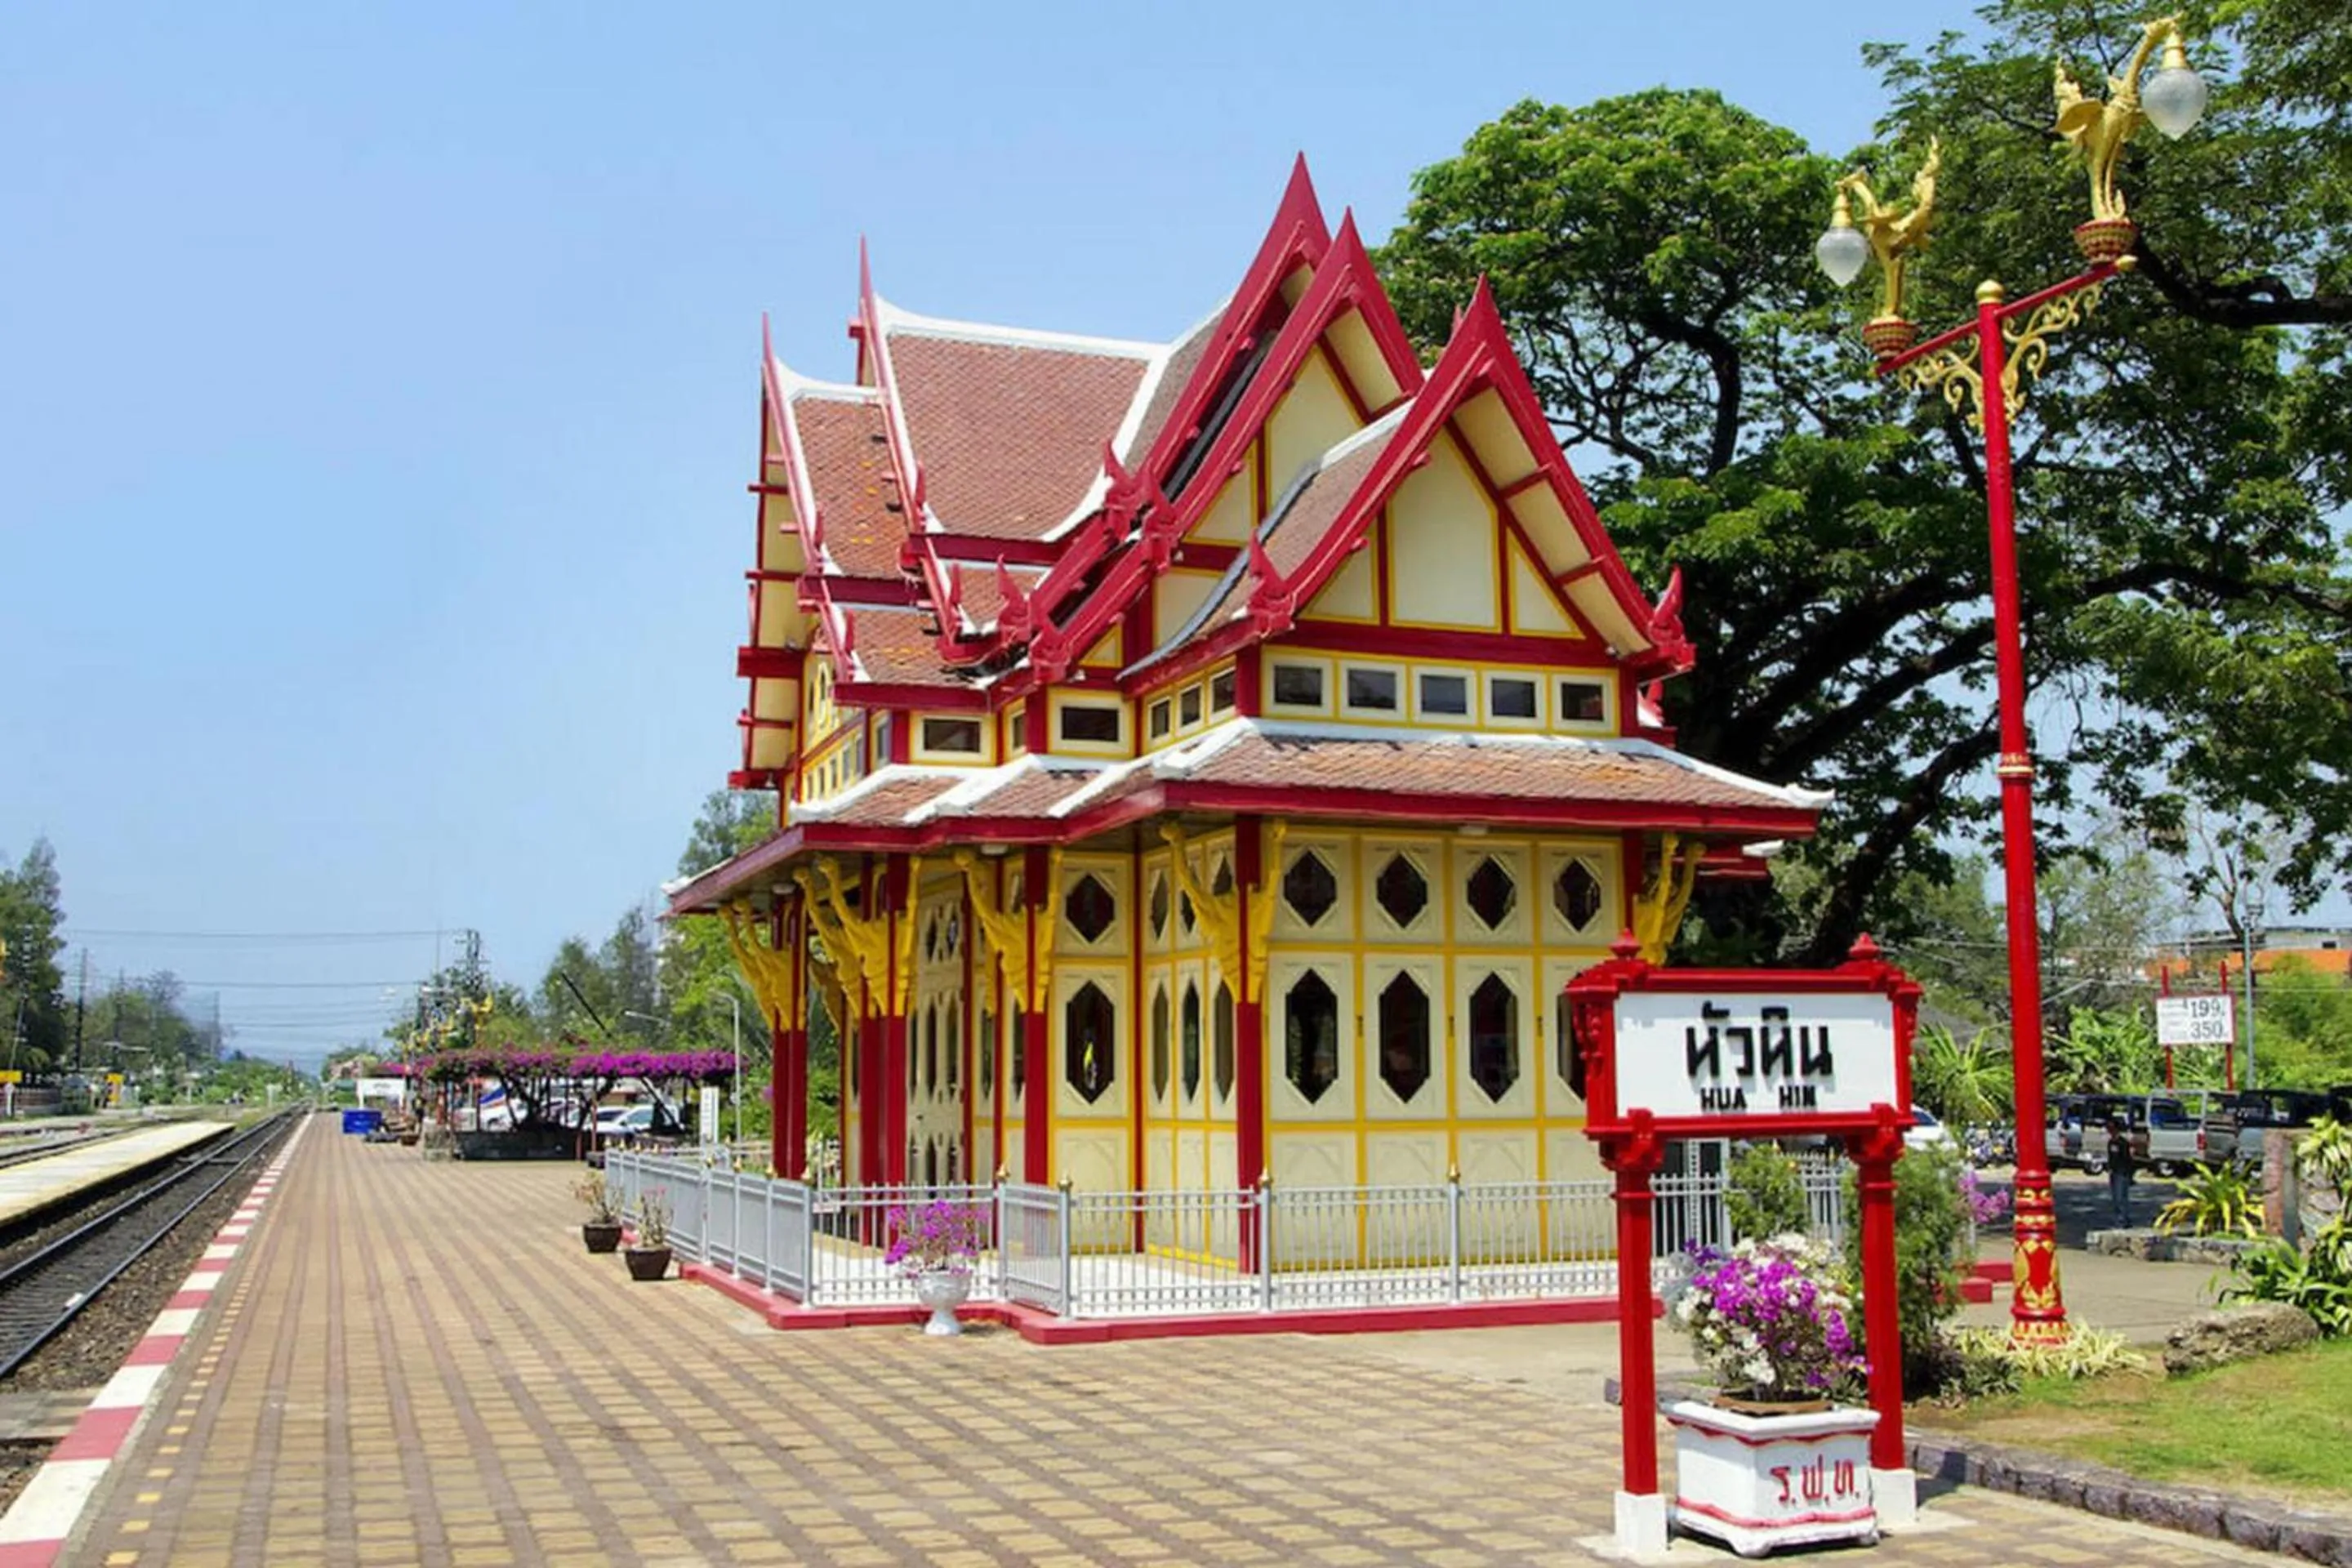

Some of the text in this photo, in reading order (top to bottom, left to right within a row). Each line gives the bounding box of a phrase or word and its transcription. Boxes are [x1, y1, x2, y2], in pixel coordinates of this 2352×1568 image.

[1686, 1000, 1833, 1077] หัวหิน
[1700, 1085, 1816, 1110] HUA HIN
